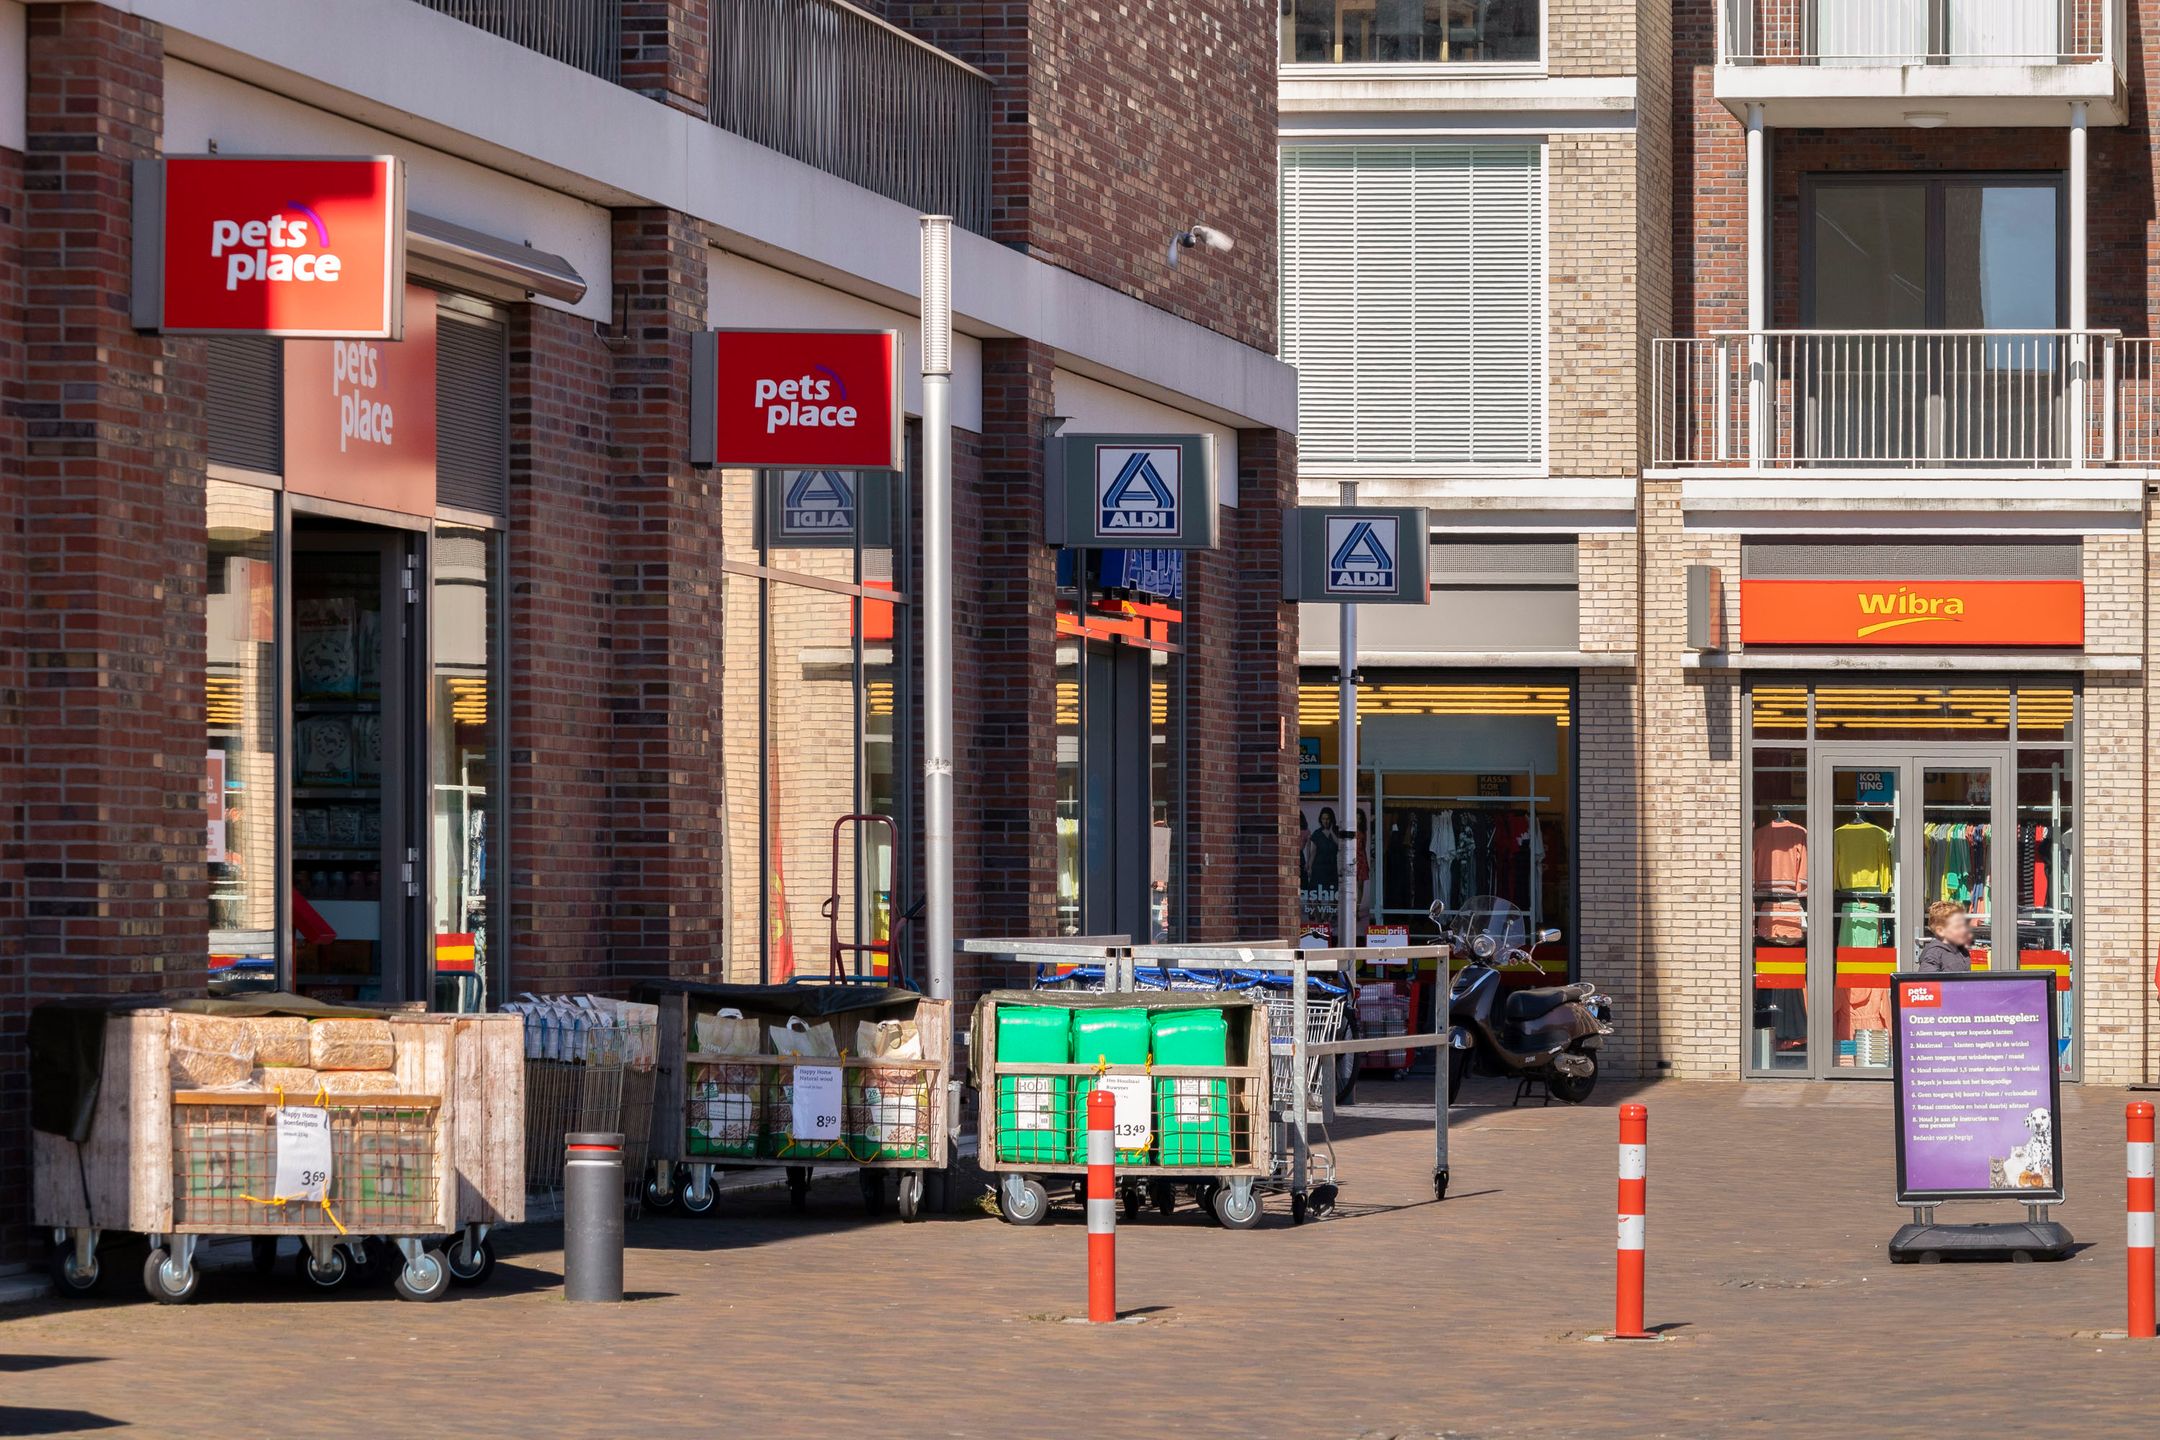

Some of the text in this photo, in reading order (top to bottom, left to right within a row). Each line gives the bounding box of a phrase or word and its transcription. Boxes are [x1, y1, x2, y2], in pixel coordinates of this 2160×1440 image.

[211, 214, 308, 257] pets
[226, 249, 341, 291] place
[333, 340, 377, 396] pets
[754, 374, 831, 408] pets
[340, 389, 394, 452] place
[766, 401, 858, 434] place
[1108, 511, 1167, 528] ALDI
[1336, 571, 1386, 586] ALDI
[1857, 586, 1965, 615] Wibra
[1299, 754, 1317, 763] SSA
[1859, 772, 1881, 781] KOR
[1859, 781, 1884, 791] TING
[1300, 884, 1339, 901] ashi
[1304, 904, 1339, 915] by Wibr
[1300, 925, 1330, 935] alprijs
[1367, 926, 1407, 936] knalprijs
[1908, 987, 1927, 997] pets
[1911, 994, 1934, 1003] place
[1909, 1012, 2040, 1025] Onze corona maatregelen:
[816, 1115, 837, 1128] 8.99
[1114, 1124, 1146, 1137] 13.49
[301, 1170, 326, 1186] 3.69
